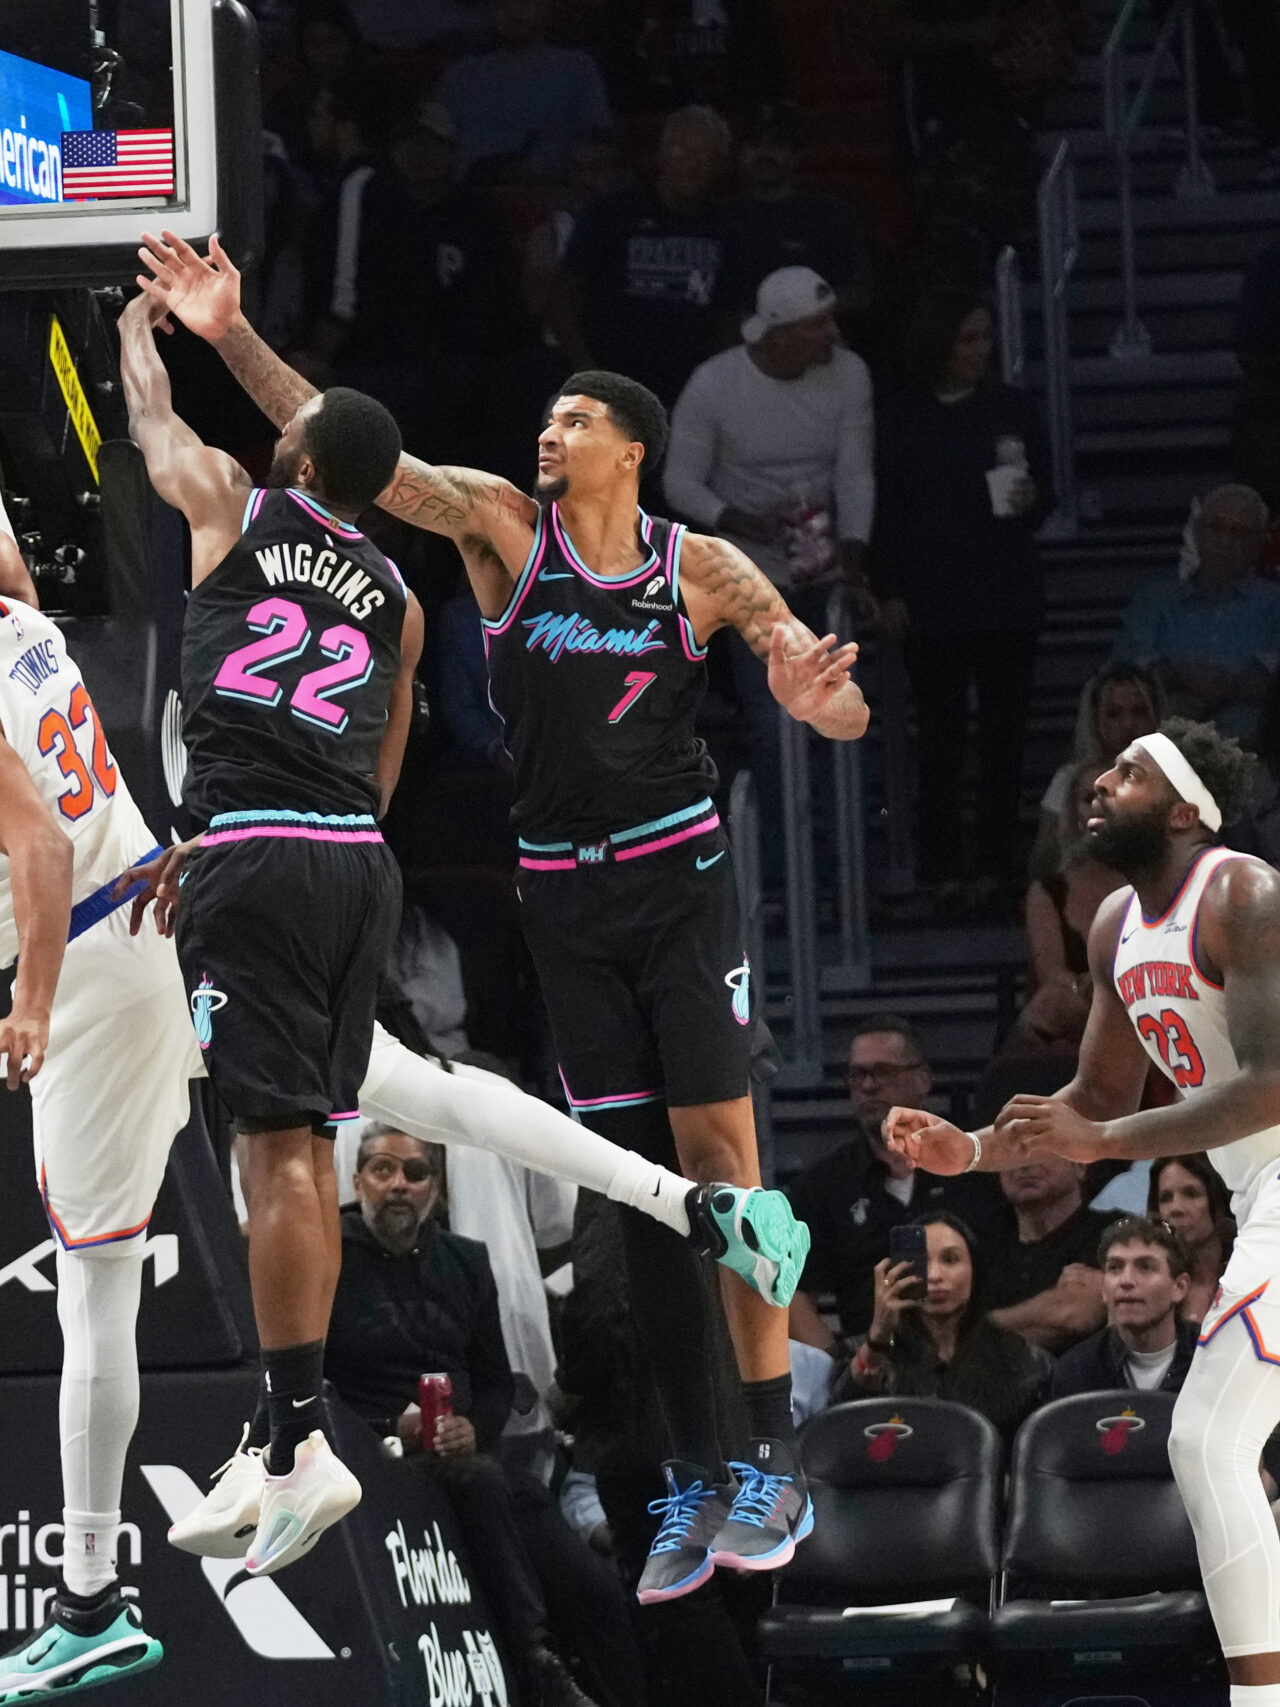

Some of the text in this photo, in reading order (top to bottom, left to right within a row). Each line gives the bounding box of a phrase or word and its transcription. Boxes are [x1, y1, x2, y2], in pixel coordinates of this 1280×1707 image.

[255, 543, 385, 620] WIGGINS
[632, 599, 673, 611] Robinhood
[9, 638, 59, 696] TOWNS
[213, 597, 375, 735] 22
[522, 611, 667, 664] Miami
[607, 671, 658, 724] 7
[37, 681, 117, 822] 32
[1117, 960, 1200, 1008] NEW YORK
[1137, 1008, 1206, 1088] 23
[385, 1518, 471, 1608] Florida
[418, 1621, 473, 1707] Blue
